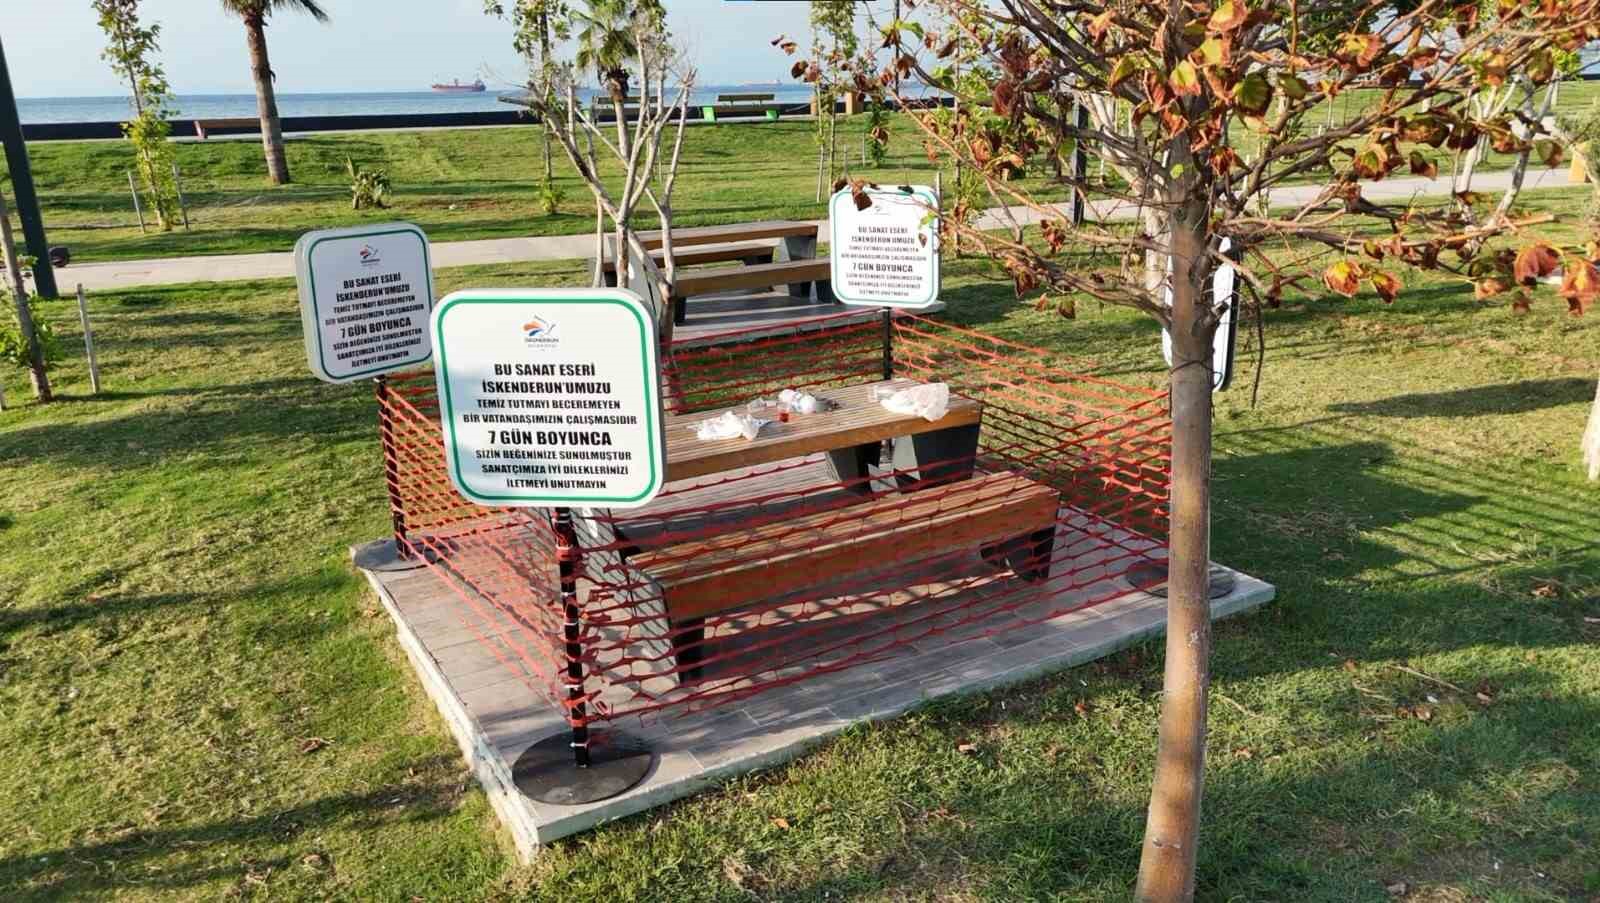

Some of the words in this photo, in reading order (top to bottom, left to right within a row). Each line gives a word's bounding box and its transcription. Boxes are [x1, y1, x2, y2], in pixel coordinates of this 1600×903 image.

[343, 280, 354, 289] BU
[355, 276, 379, 287] SANAT
[340, 328, 345, 338] 7
[348, 323, 367, 337] GÜN
[368, 317, 412, 333] BOYUNCA
[495, 364, 512, 376] BU
[515, 364, 555, 376] SANAT
[559, 362, 595, 376] ESERİ
[482, 378, 611, 394] İSKENDERUN'UMUZU
[477, 398, 505, 409] TEMİZ
[508, 399, 550, 409] TUTMAYI
[552, 400, 621, 409] BECEREMEYEN
[463, 412, 480, 423] BİR
[566, 415, 637, 426] ÇALIŞMASIDIR
[488, 430, 496, 444] 7
[500, 428, 533, 445] GÜN
[536, 431, 612, 446] BOYUNCA
[475, 448, 500, 459] SİZİN
[481, 463, 546, 475] SANATÇIMIZA
[548, 463, 561, 474] İYİ
[563, 464, 629, 475] DİLEKLERİNİZİ
[506, 478, 548, 488] İLETMEYİ
[550, 479, 607, 489] UNUTMAYIN
